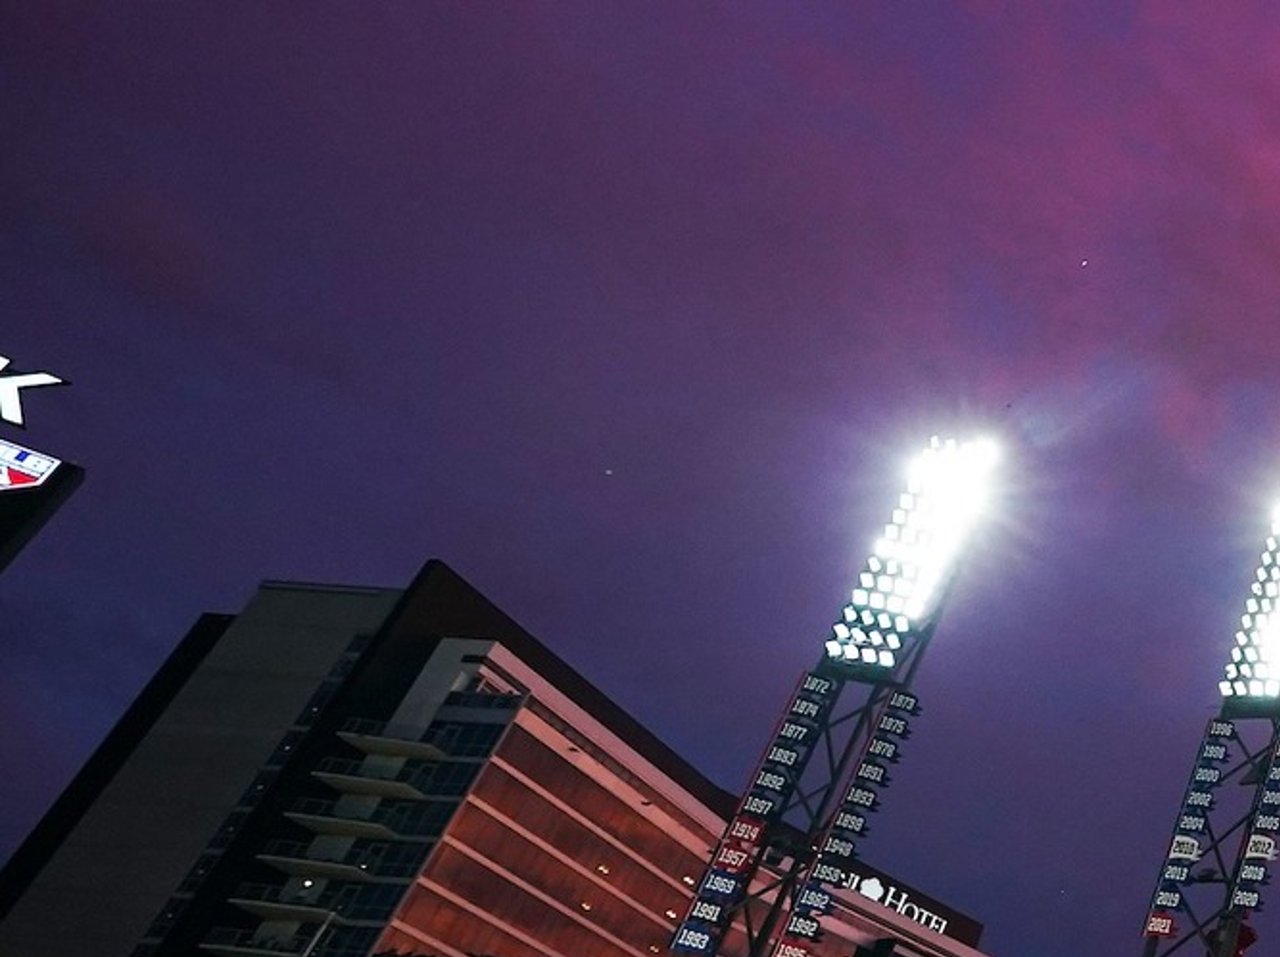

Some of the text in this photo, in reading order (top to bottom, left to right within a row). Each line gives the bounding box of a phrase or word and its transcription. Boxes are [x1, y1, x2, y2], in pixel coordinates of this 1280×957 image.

[780, 723, 807, 740] 1877
[744, 796, 773, 815] 1897
[731, 822, 760, 842] 1914
[718, 848, 748, 867] 1957
[692, 902, 721, 923] 1991
